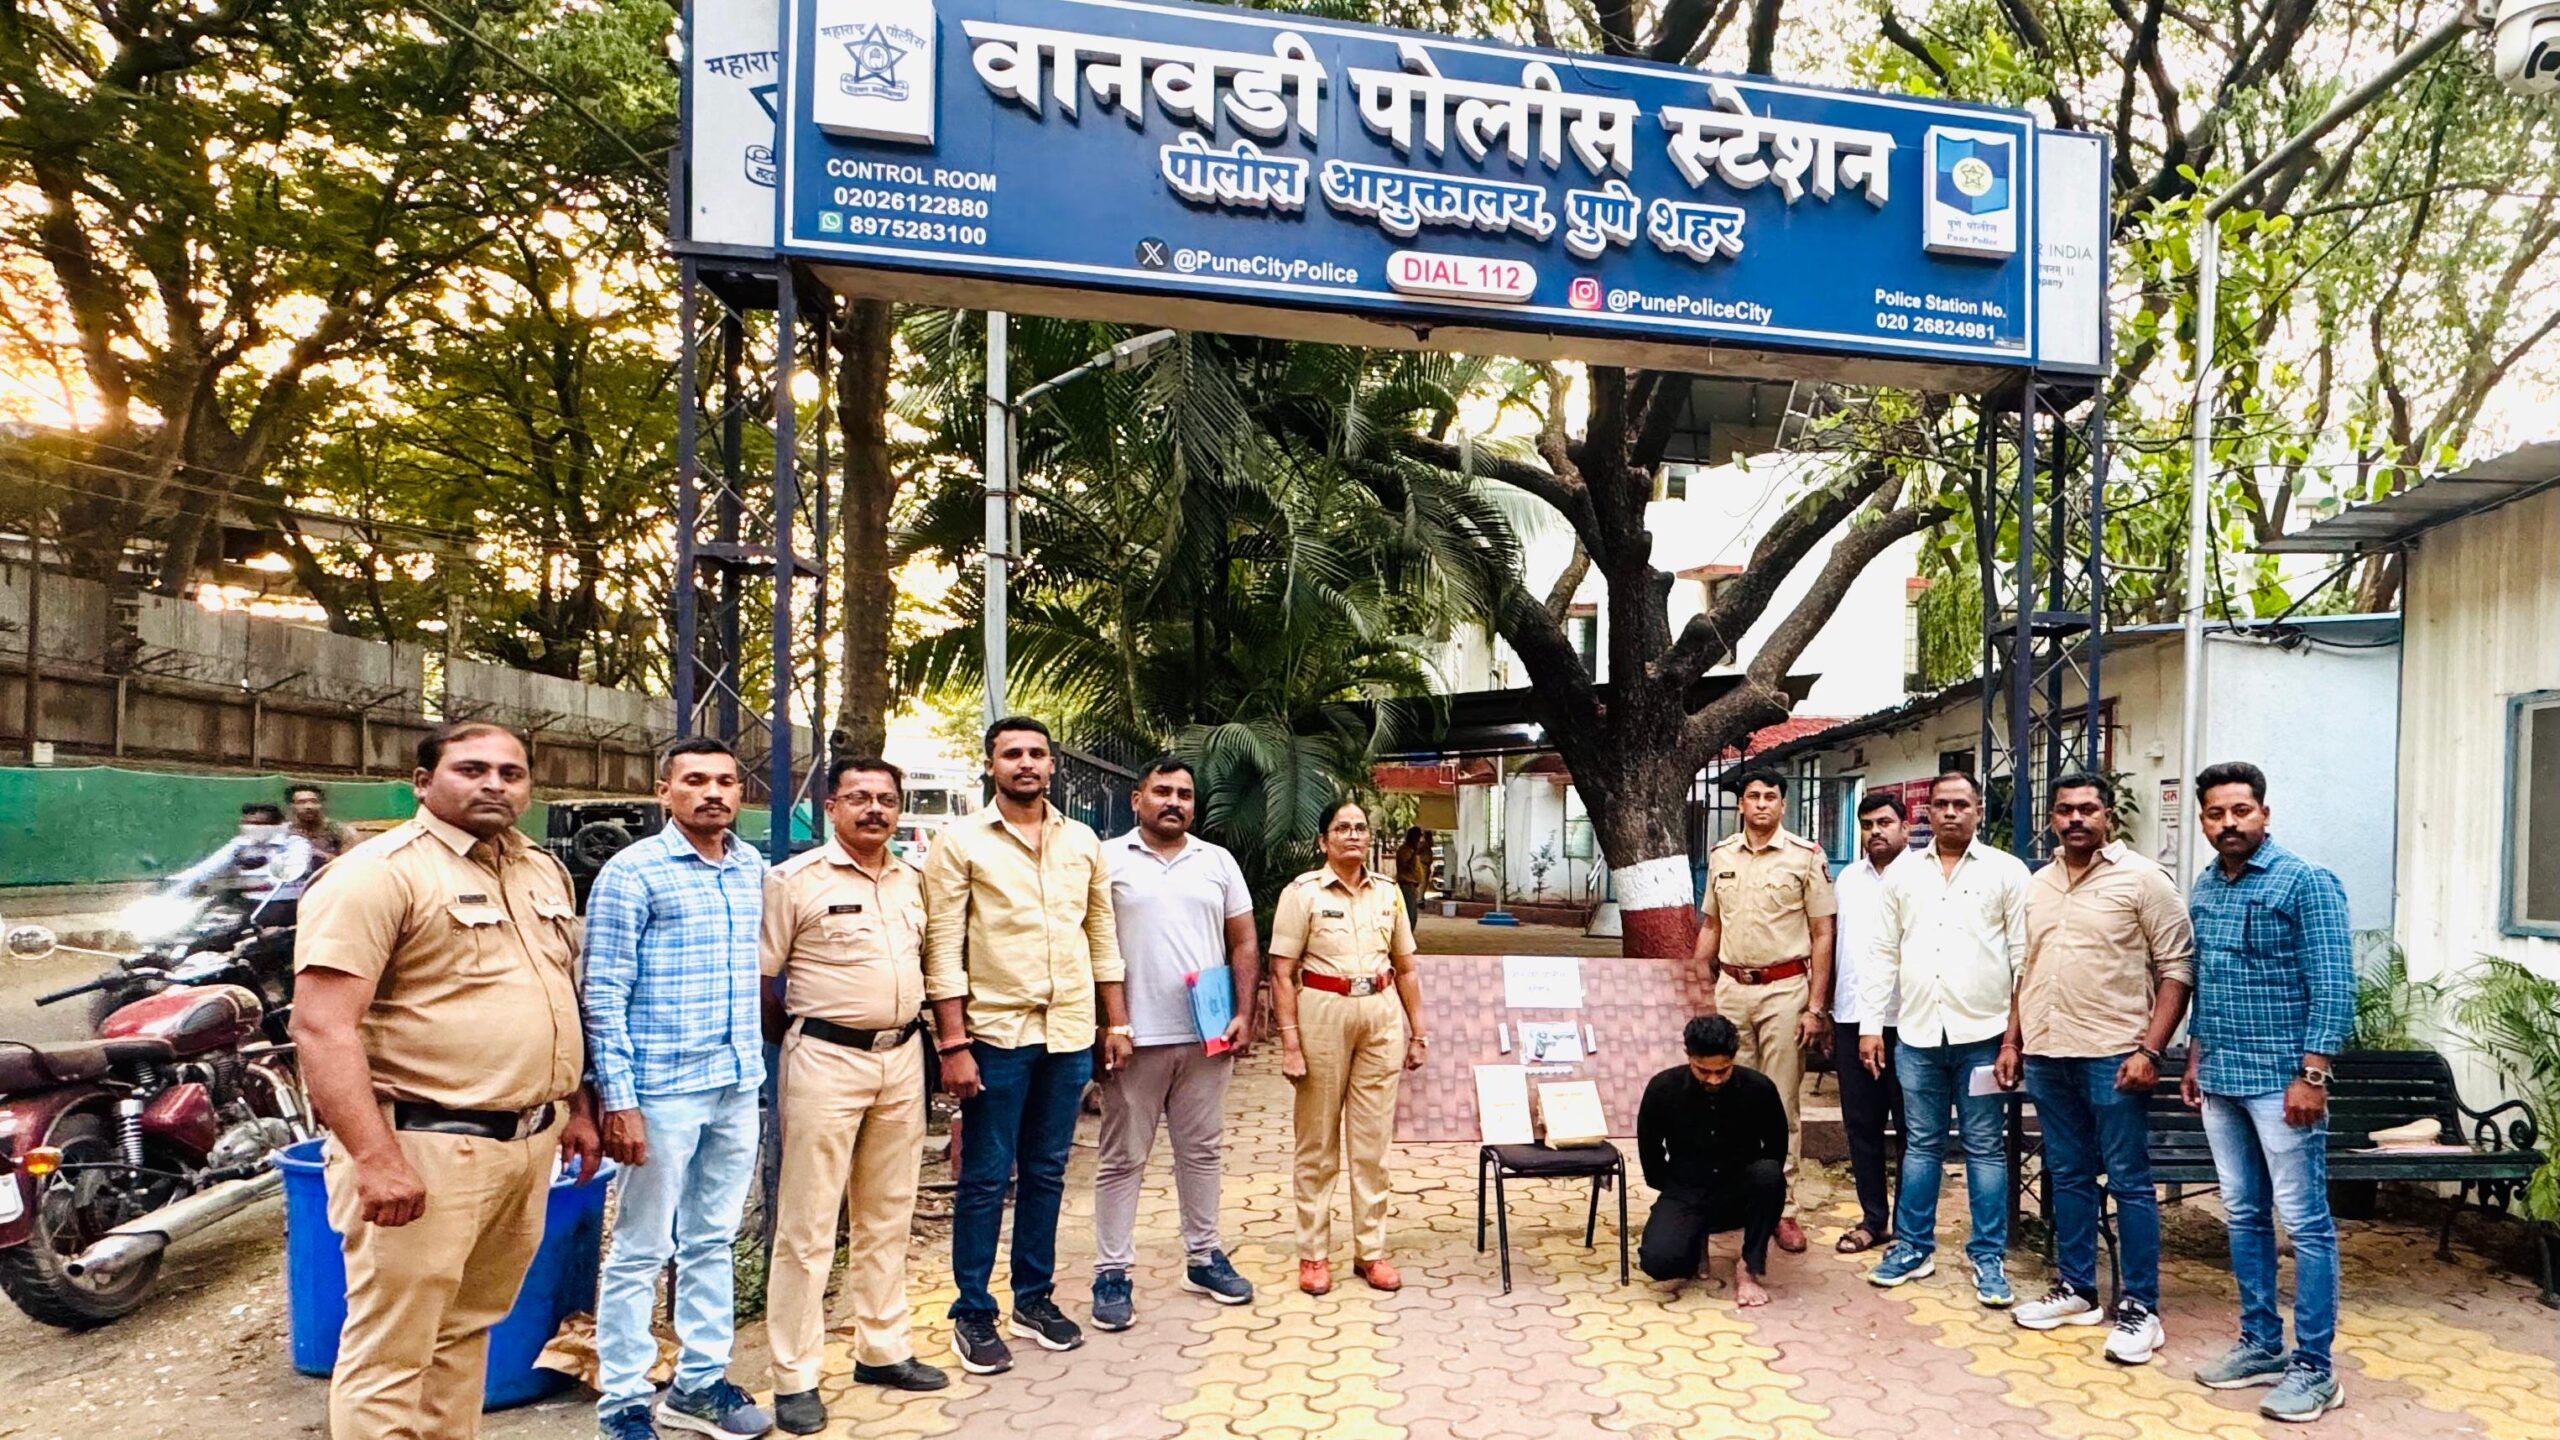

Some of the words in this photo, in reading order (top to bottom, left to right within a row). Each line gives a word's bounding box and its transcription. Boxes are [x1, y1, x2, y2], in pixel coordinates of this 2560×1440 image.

[886, 23, 927, 50] पोलीस
[961, 19, 1327, 144] वानवडी
[1347, 41, 1640, 177] पोलीस
[1658, 79, 1896, 208] स्टेशन
[826, 158, 929, 186] CONTROL
[933, 169, 997, 193] ROOM
[834, 187, 988, 218] 02026122880
[1160, 130, 1309, 212] पोलीस
[1320, 159, 1556, 242] आयुक्तालय,
[1564, 179, 1640, 260] पुणे
[1647, 198, 1745, 264] शहर
[849, 215, 987, 246] 8975283100
[1174, 248, 1358, 284] @PuneCityPolice
[2049, 243, 2094, 261] INDIA
[1405, 257, 1468, 286] DIAL
[1477, 264, 1520, 290] 112
[1607, 289, 1772, 326] @PunePoliceCity
[1875, 288, 1921, 309] Police
[1925, 294, 1978, 315] Station
[1982, 301, 2007, 319] No.
[1876, 312, 1909, 331] 020
[1913, 316, 1995, 340] 26824981
